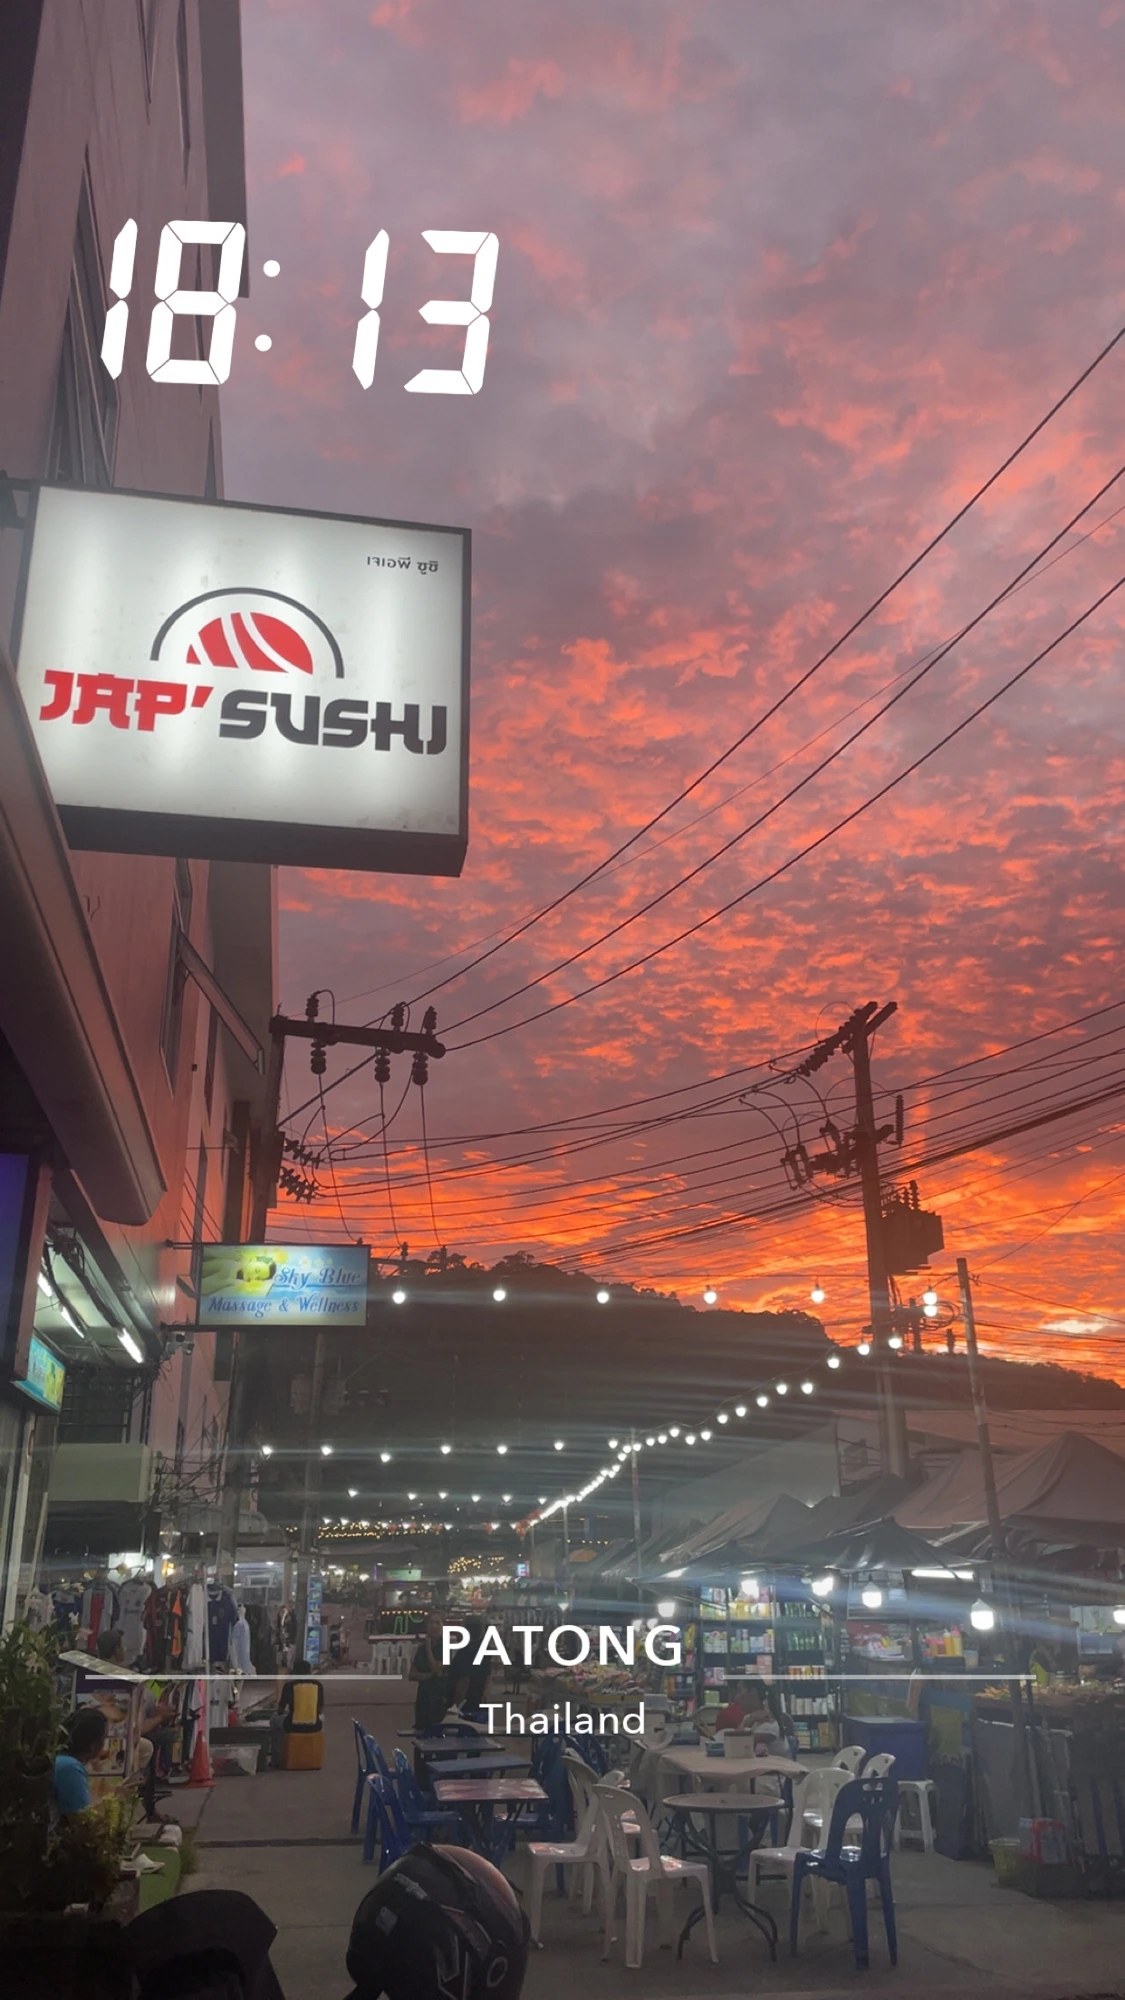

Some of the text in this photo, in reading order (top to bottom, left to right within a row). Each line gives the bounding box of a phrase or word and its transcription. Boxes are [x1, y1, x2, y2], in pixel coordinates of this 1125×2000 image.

[219, 689, 448, 755] SUSHI
[276, 1266, 361, 1290] Sky Blue
[208, 1294, 360, 1318] Massage & Wellness
